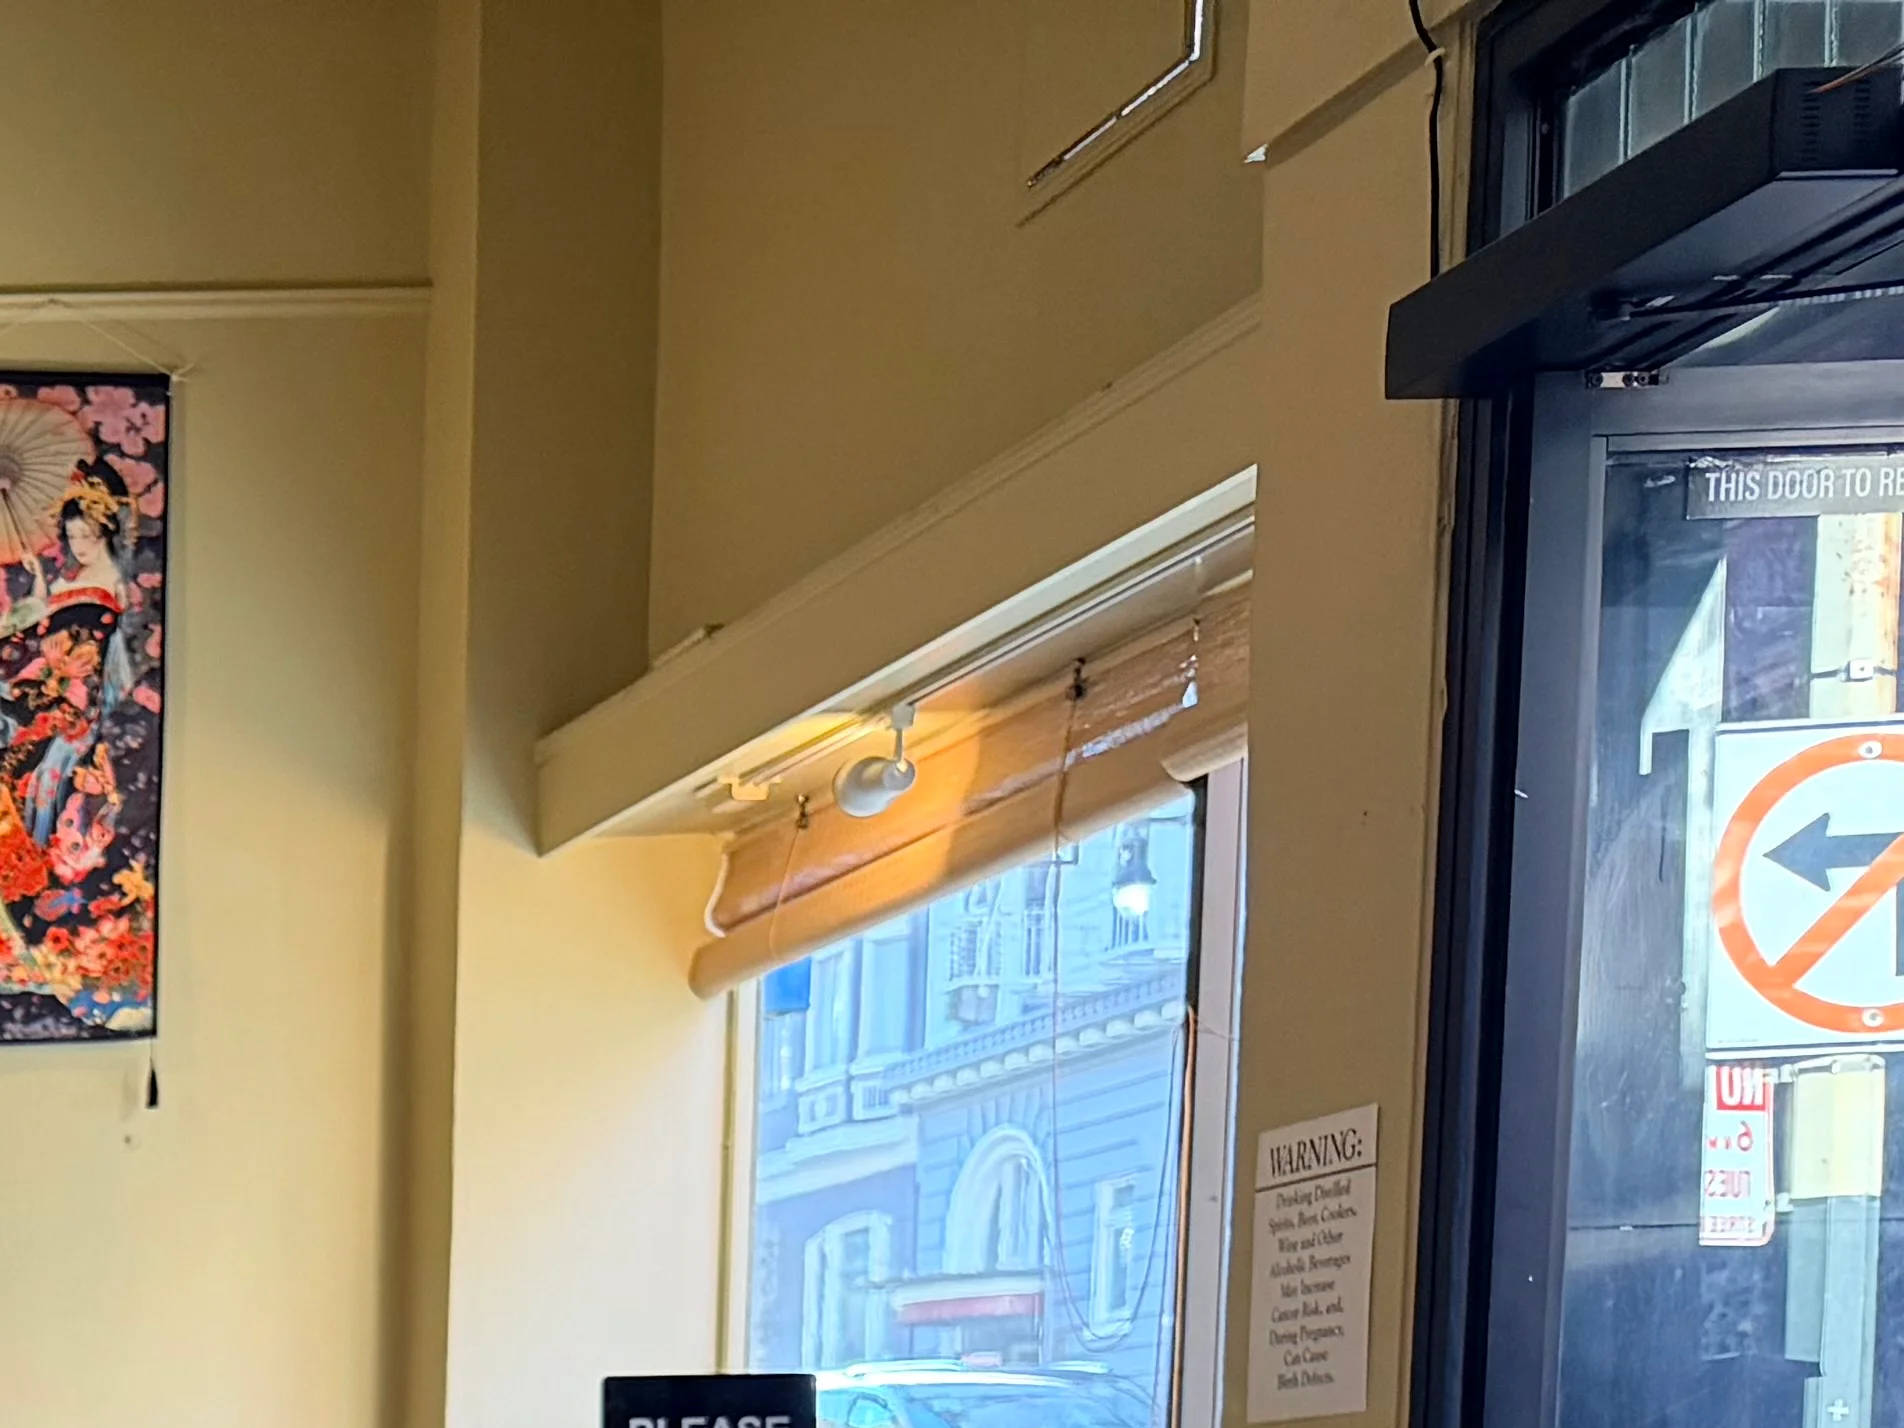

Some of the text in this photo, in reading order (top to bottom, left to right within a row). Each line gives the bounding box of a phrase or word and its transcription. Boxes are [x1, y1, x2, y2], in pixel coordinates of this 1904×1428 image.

[1705, 471, 1761, 502] THIS
[1767, 469, 1835, 501] DOOR
[1841, 468, 1871, 498] TO
[1269, 1127, 1363, 1178] WARNING:
